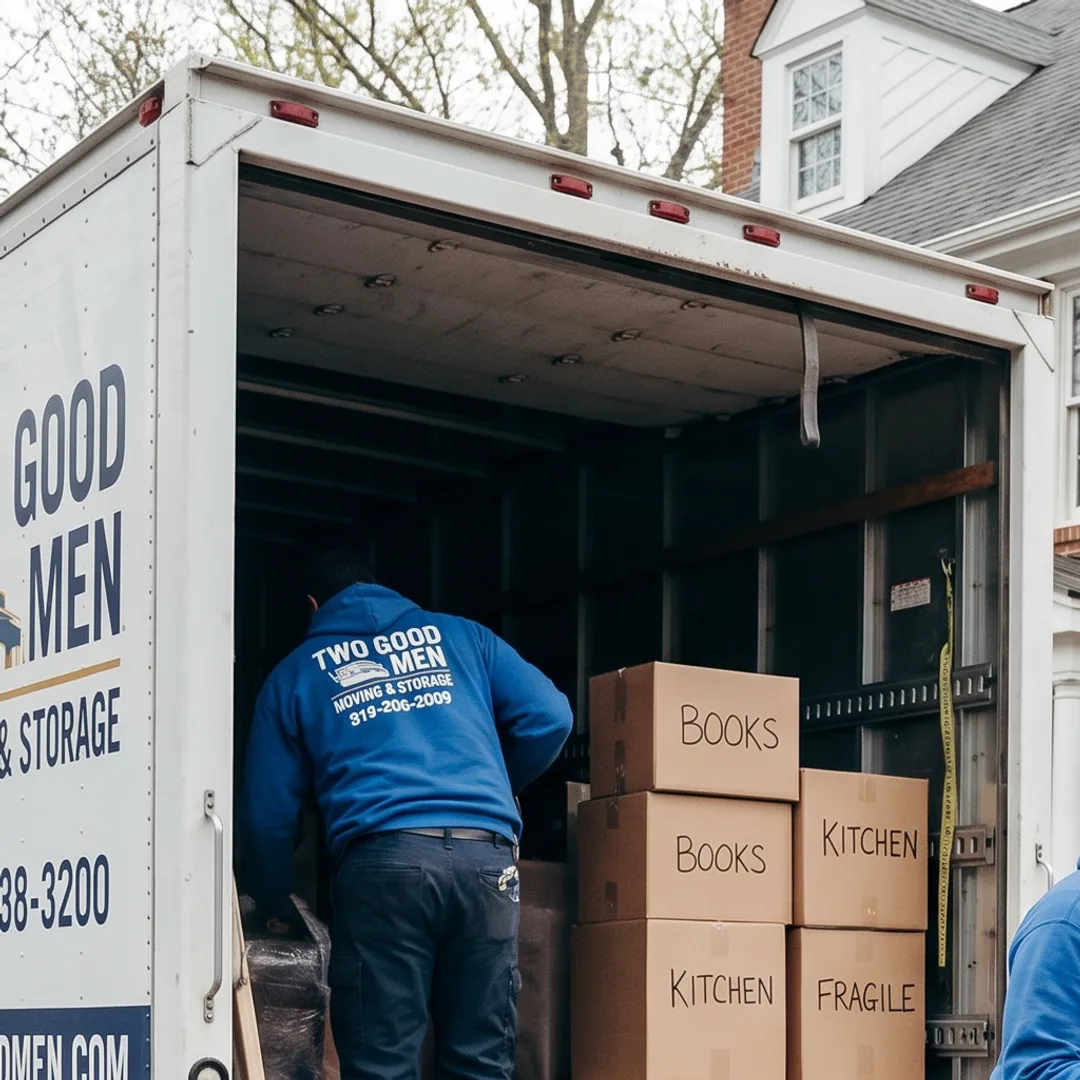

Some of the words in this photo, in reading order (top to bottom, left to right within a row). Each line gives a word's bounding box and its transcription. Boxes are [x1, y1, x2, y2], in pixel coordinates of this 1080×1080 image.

[14, 363, 126, 527] GOOD
[29, 510, 122, 662] MEN
[312, 640, 369, 671] TWO
[373, 625, 442, 655] GOOD
[389, 646, 448, 675] MEN
[333, 686, 383, 714] MOVING
[385, 683, 396, 696] &
[397, 673, 453, 695] STORAGE
[19, 687, 120, 774] STORAGE
[681, 704, 779, 751] BOOKS
[676, 835, 766, 874] BOOKS
[822, 818, 918, 860] KITCHEN
[0, 854, 109, 933] 38-3200
[670, 968, 773, 1008] KITCHEN
[817, 977, 916, 1013] FRAGILE
